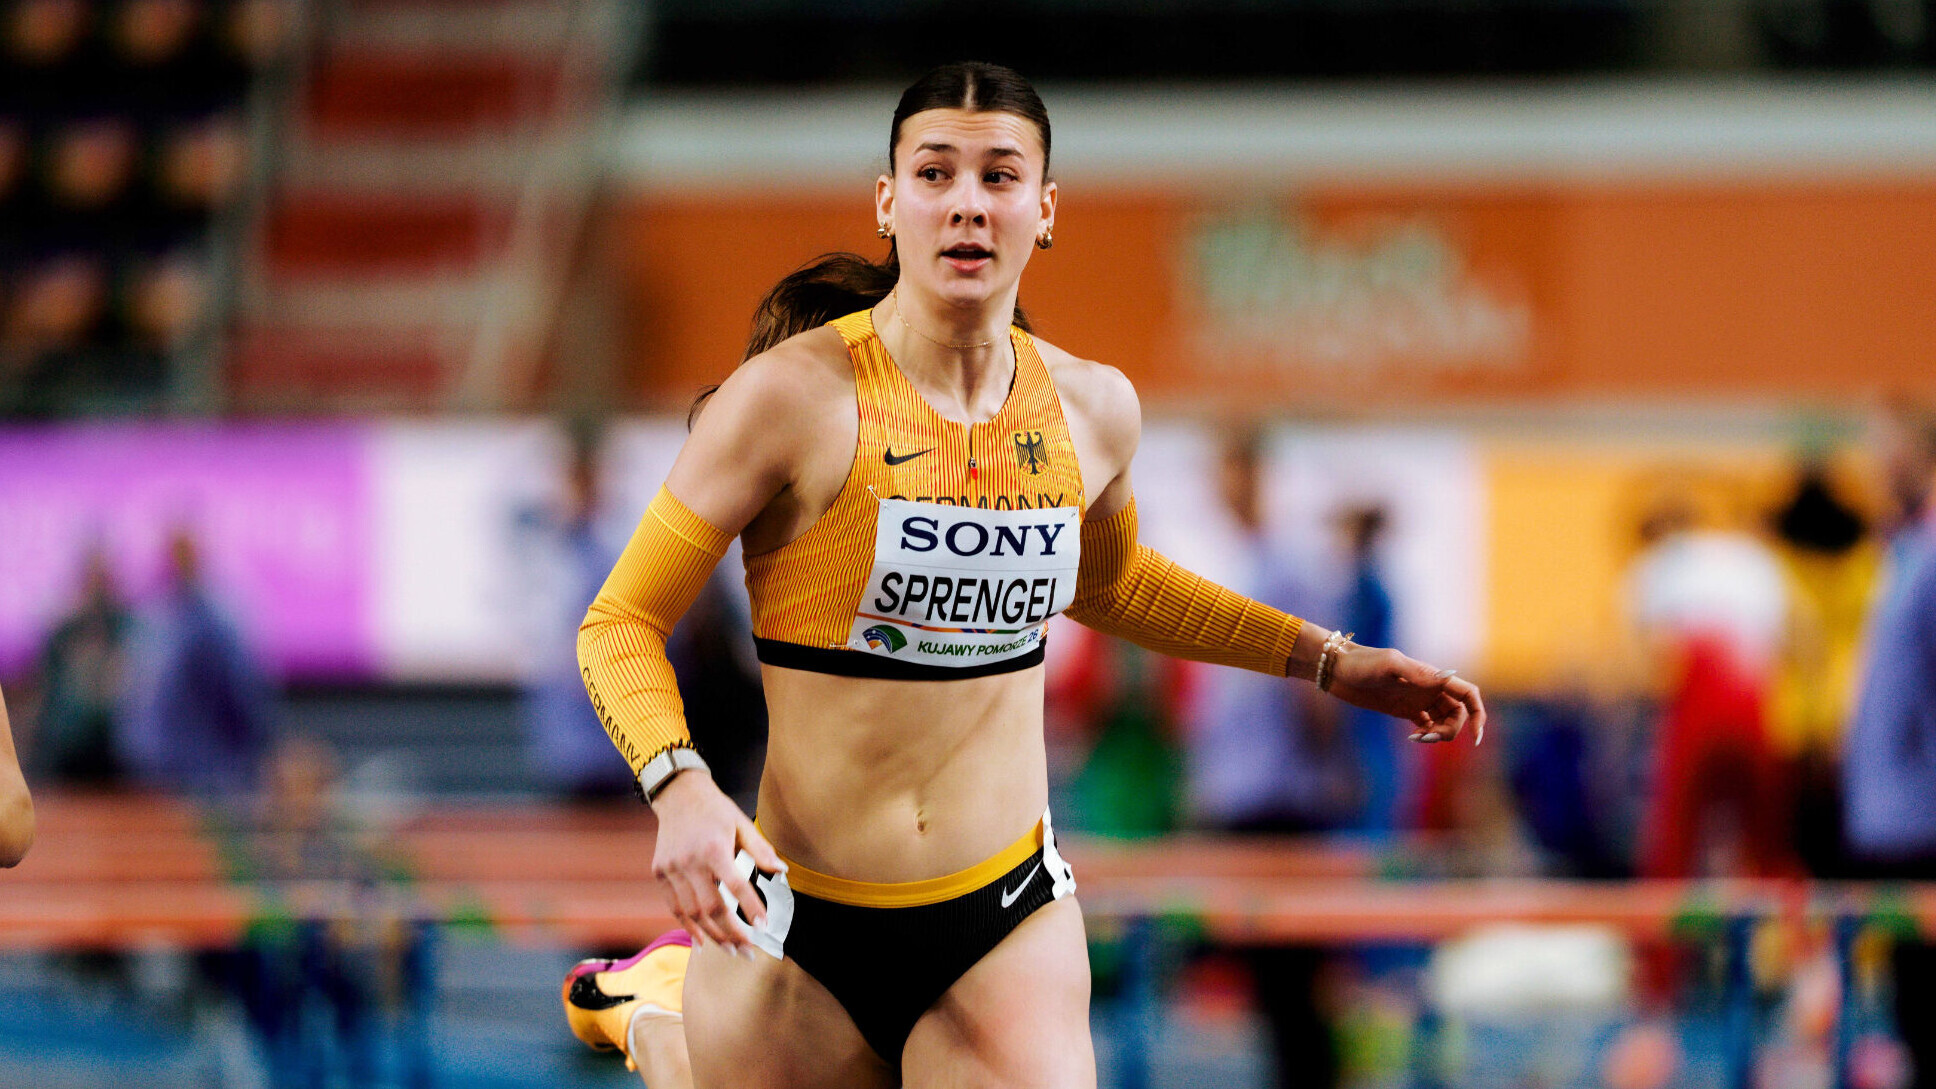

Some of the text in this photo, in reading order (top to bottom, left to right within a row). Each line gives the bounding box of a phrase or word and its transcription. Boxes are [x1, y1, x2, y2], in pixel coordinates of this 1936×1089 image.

[900, 516, 1065, 557] SONY
[874, 571, 1057, 624] SPRENGEL
[917, 640, 975, 657] KUJAWY
[976, 635, 1028, 656] POMORZE
